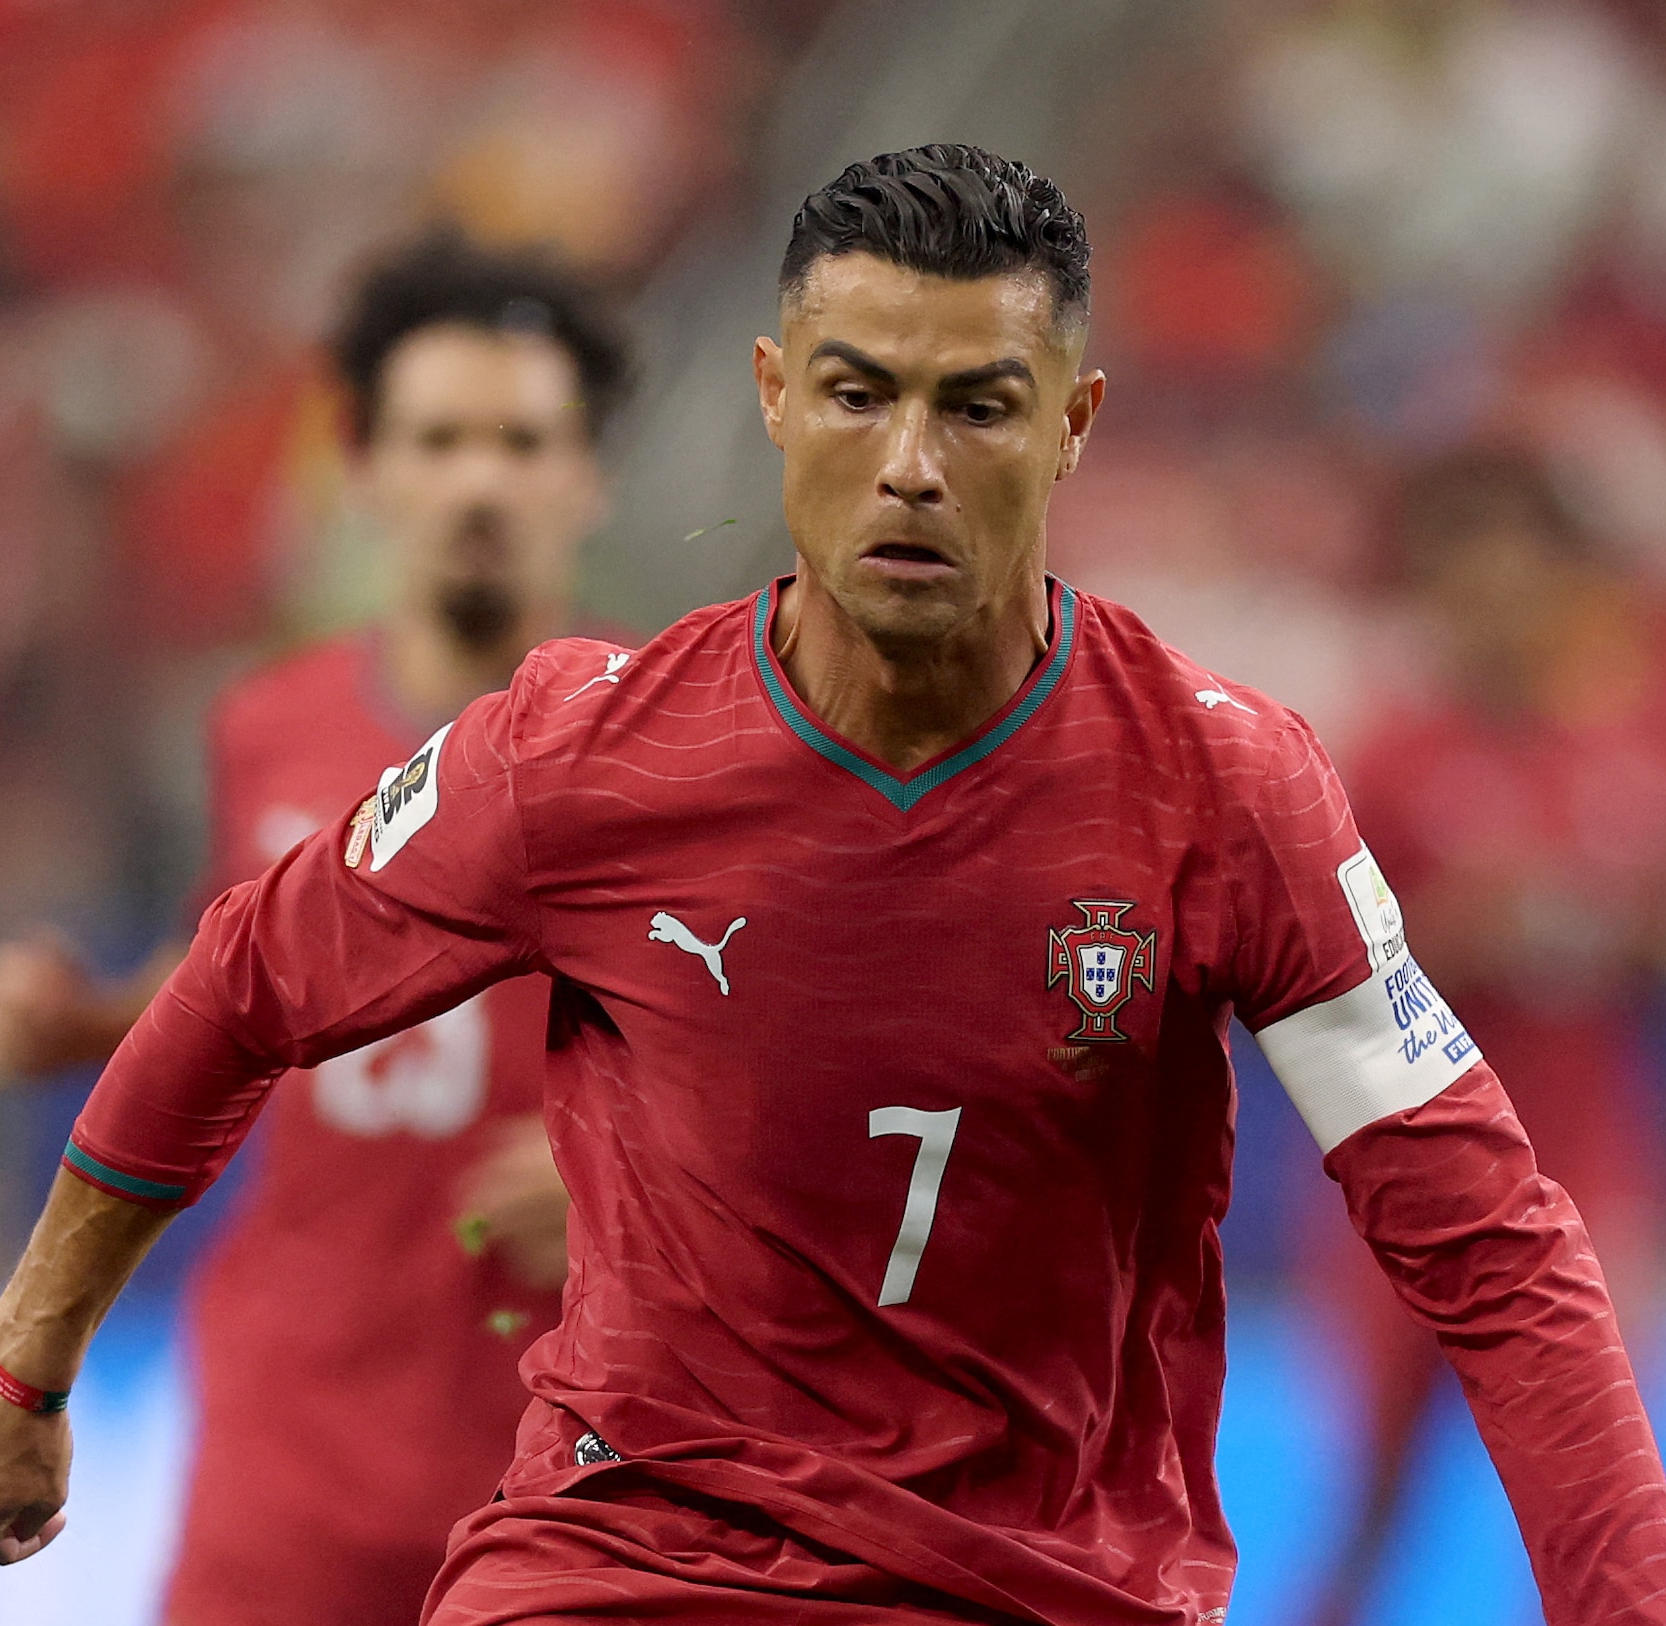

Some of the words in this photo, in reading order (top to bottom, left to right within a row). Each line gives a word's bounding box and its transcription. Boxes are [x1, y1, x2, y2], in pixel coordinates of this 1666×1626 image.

[1392, 974, 1437, 1030] UNIT
[1398, 1030, 1437, 1064] the
[869, 1106, 962, 1307] 7
